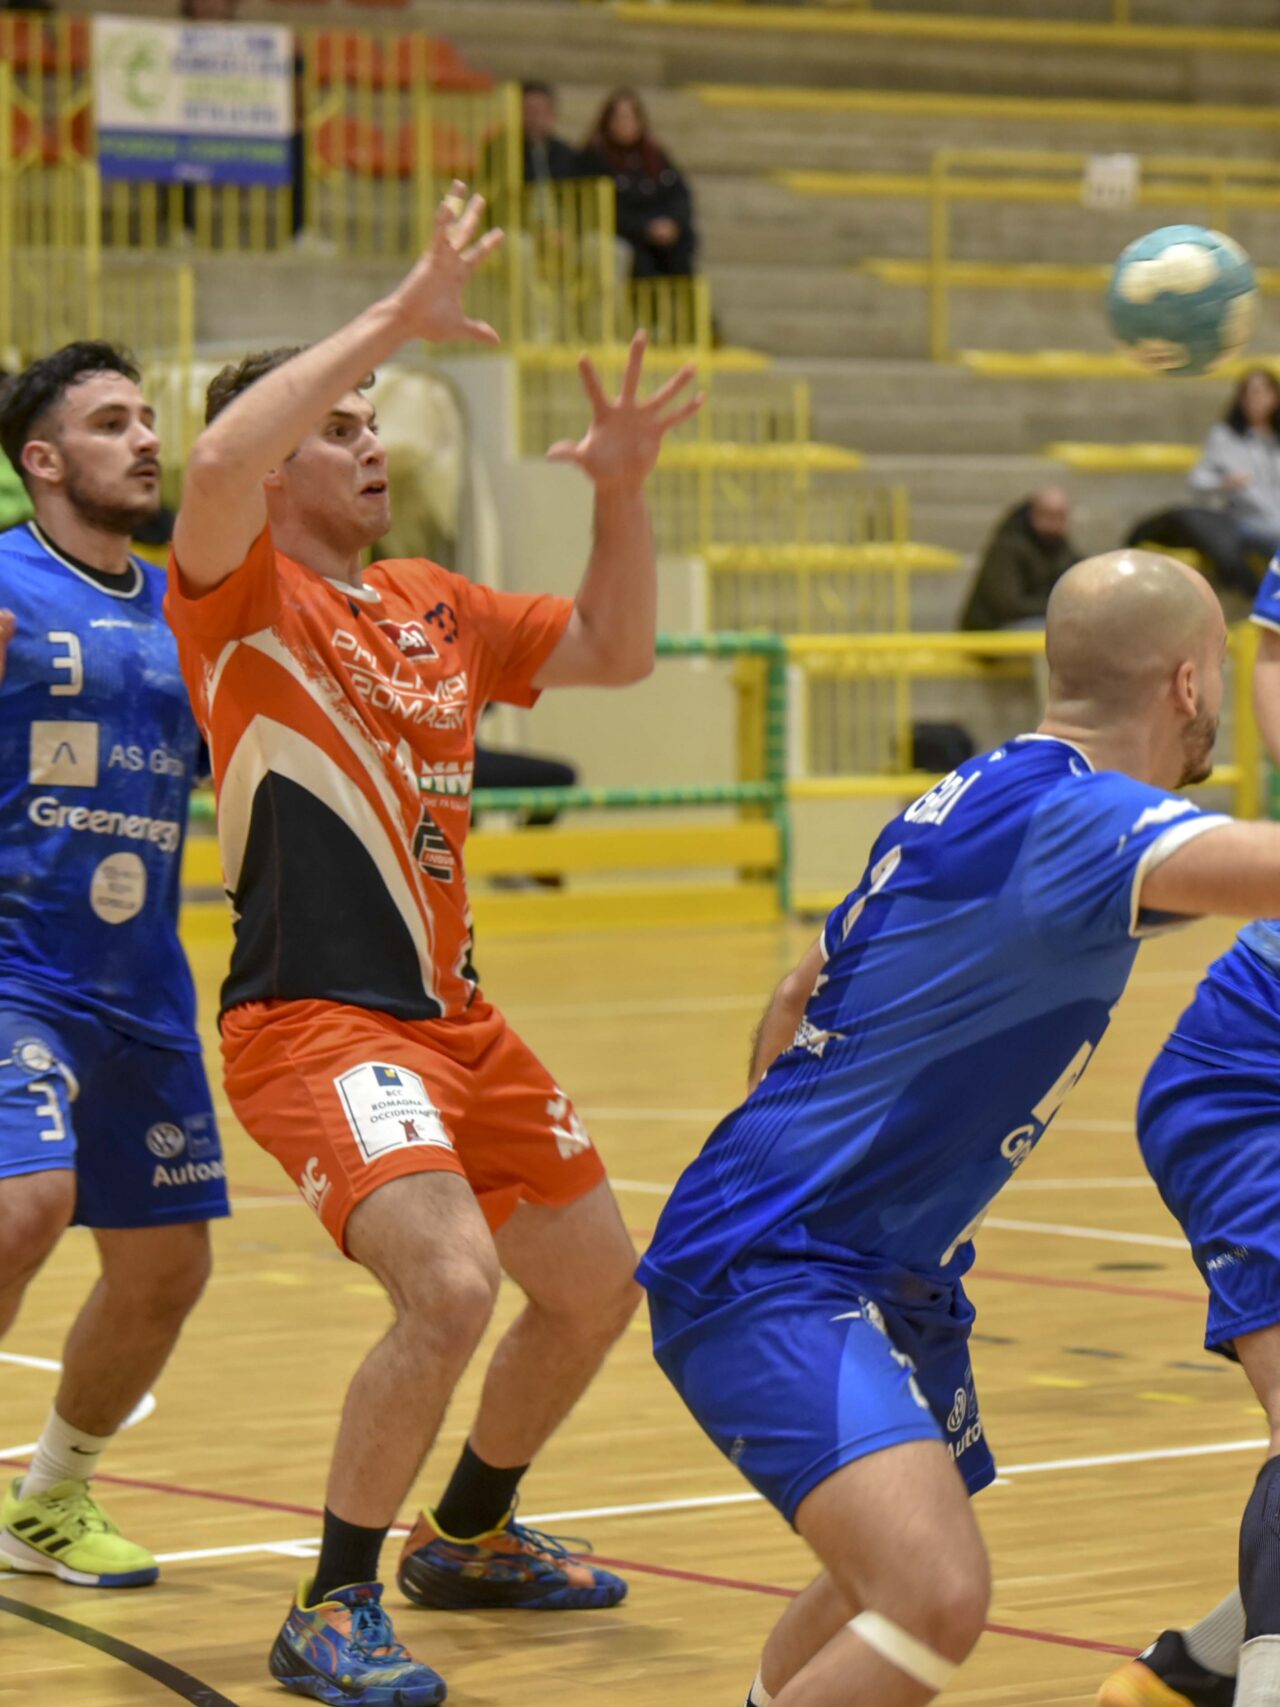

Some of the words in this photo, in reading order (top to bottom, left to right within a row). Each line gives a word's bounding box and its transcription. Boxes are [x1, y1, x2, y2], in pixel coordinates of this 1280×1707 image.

[48, 631, 83, 696] 3
[108, 744, 144, 771] AS
[28, 1082, 66, 1141] 3
